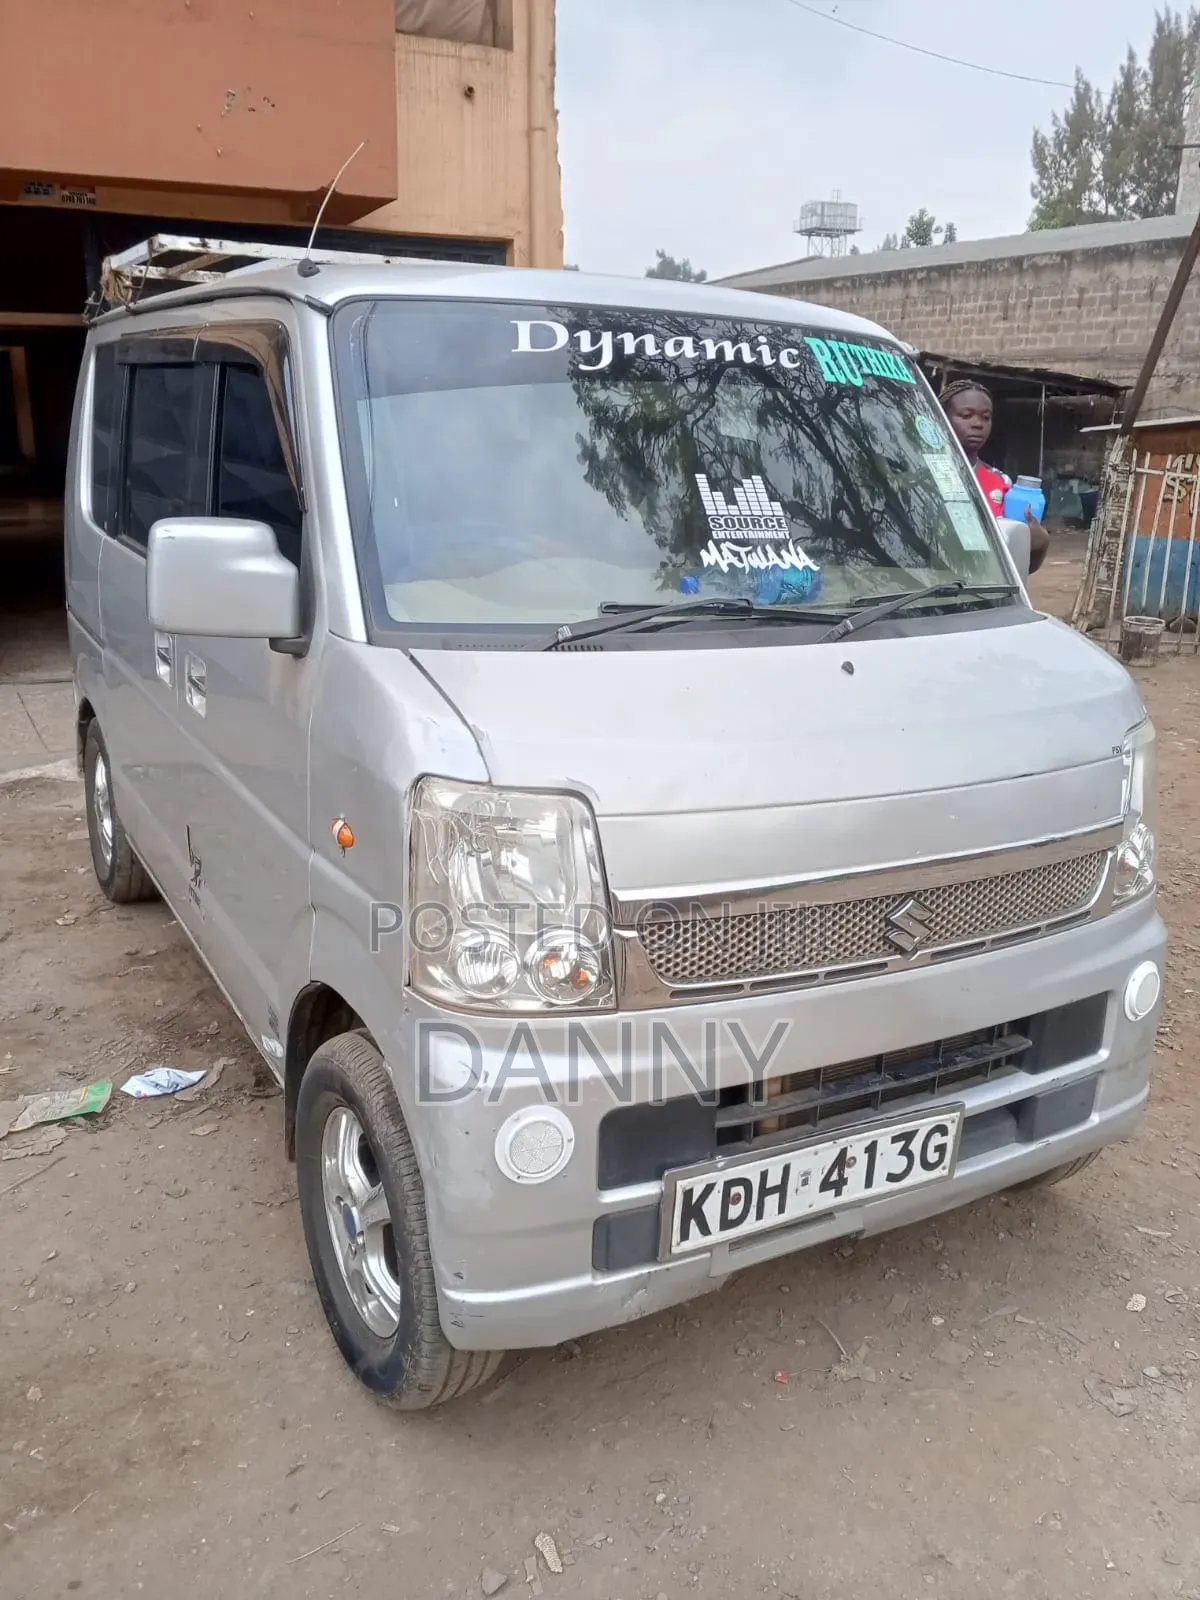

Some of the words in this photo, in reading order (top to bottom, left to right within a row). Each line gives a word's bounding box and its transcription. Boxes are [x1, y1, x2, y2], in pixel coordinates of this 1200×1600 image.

[510, 319, 801, 372] Dynamic
[803, 336, 917, 387] RUTHIKA
[708, 516, 789, 531] SOURCE
[711, 530, 791, 540] ENTERTAINMENT
[680, 1163, 792, 1242] KDH
[819, 1124, 949, 1198] 413G
